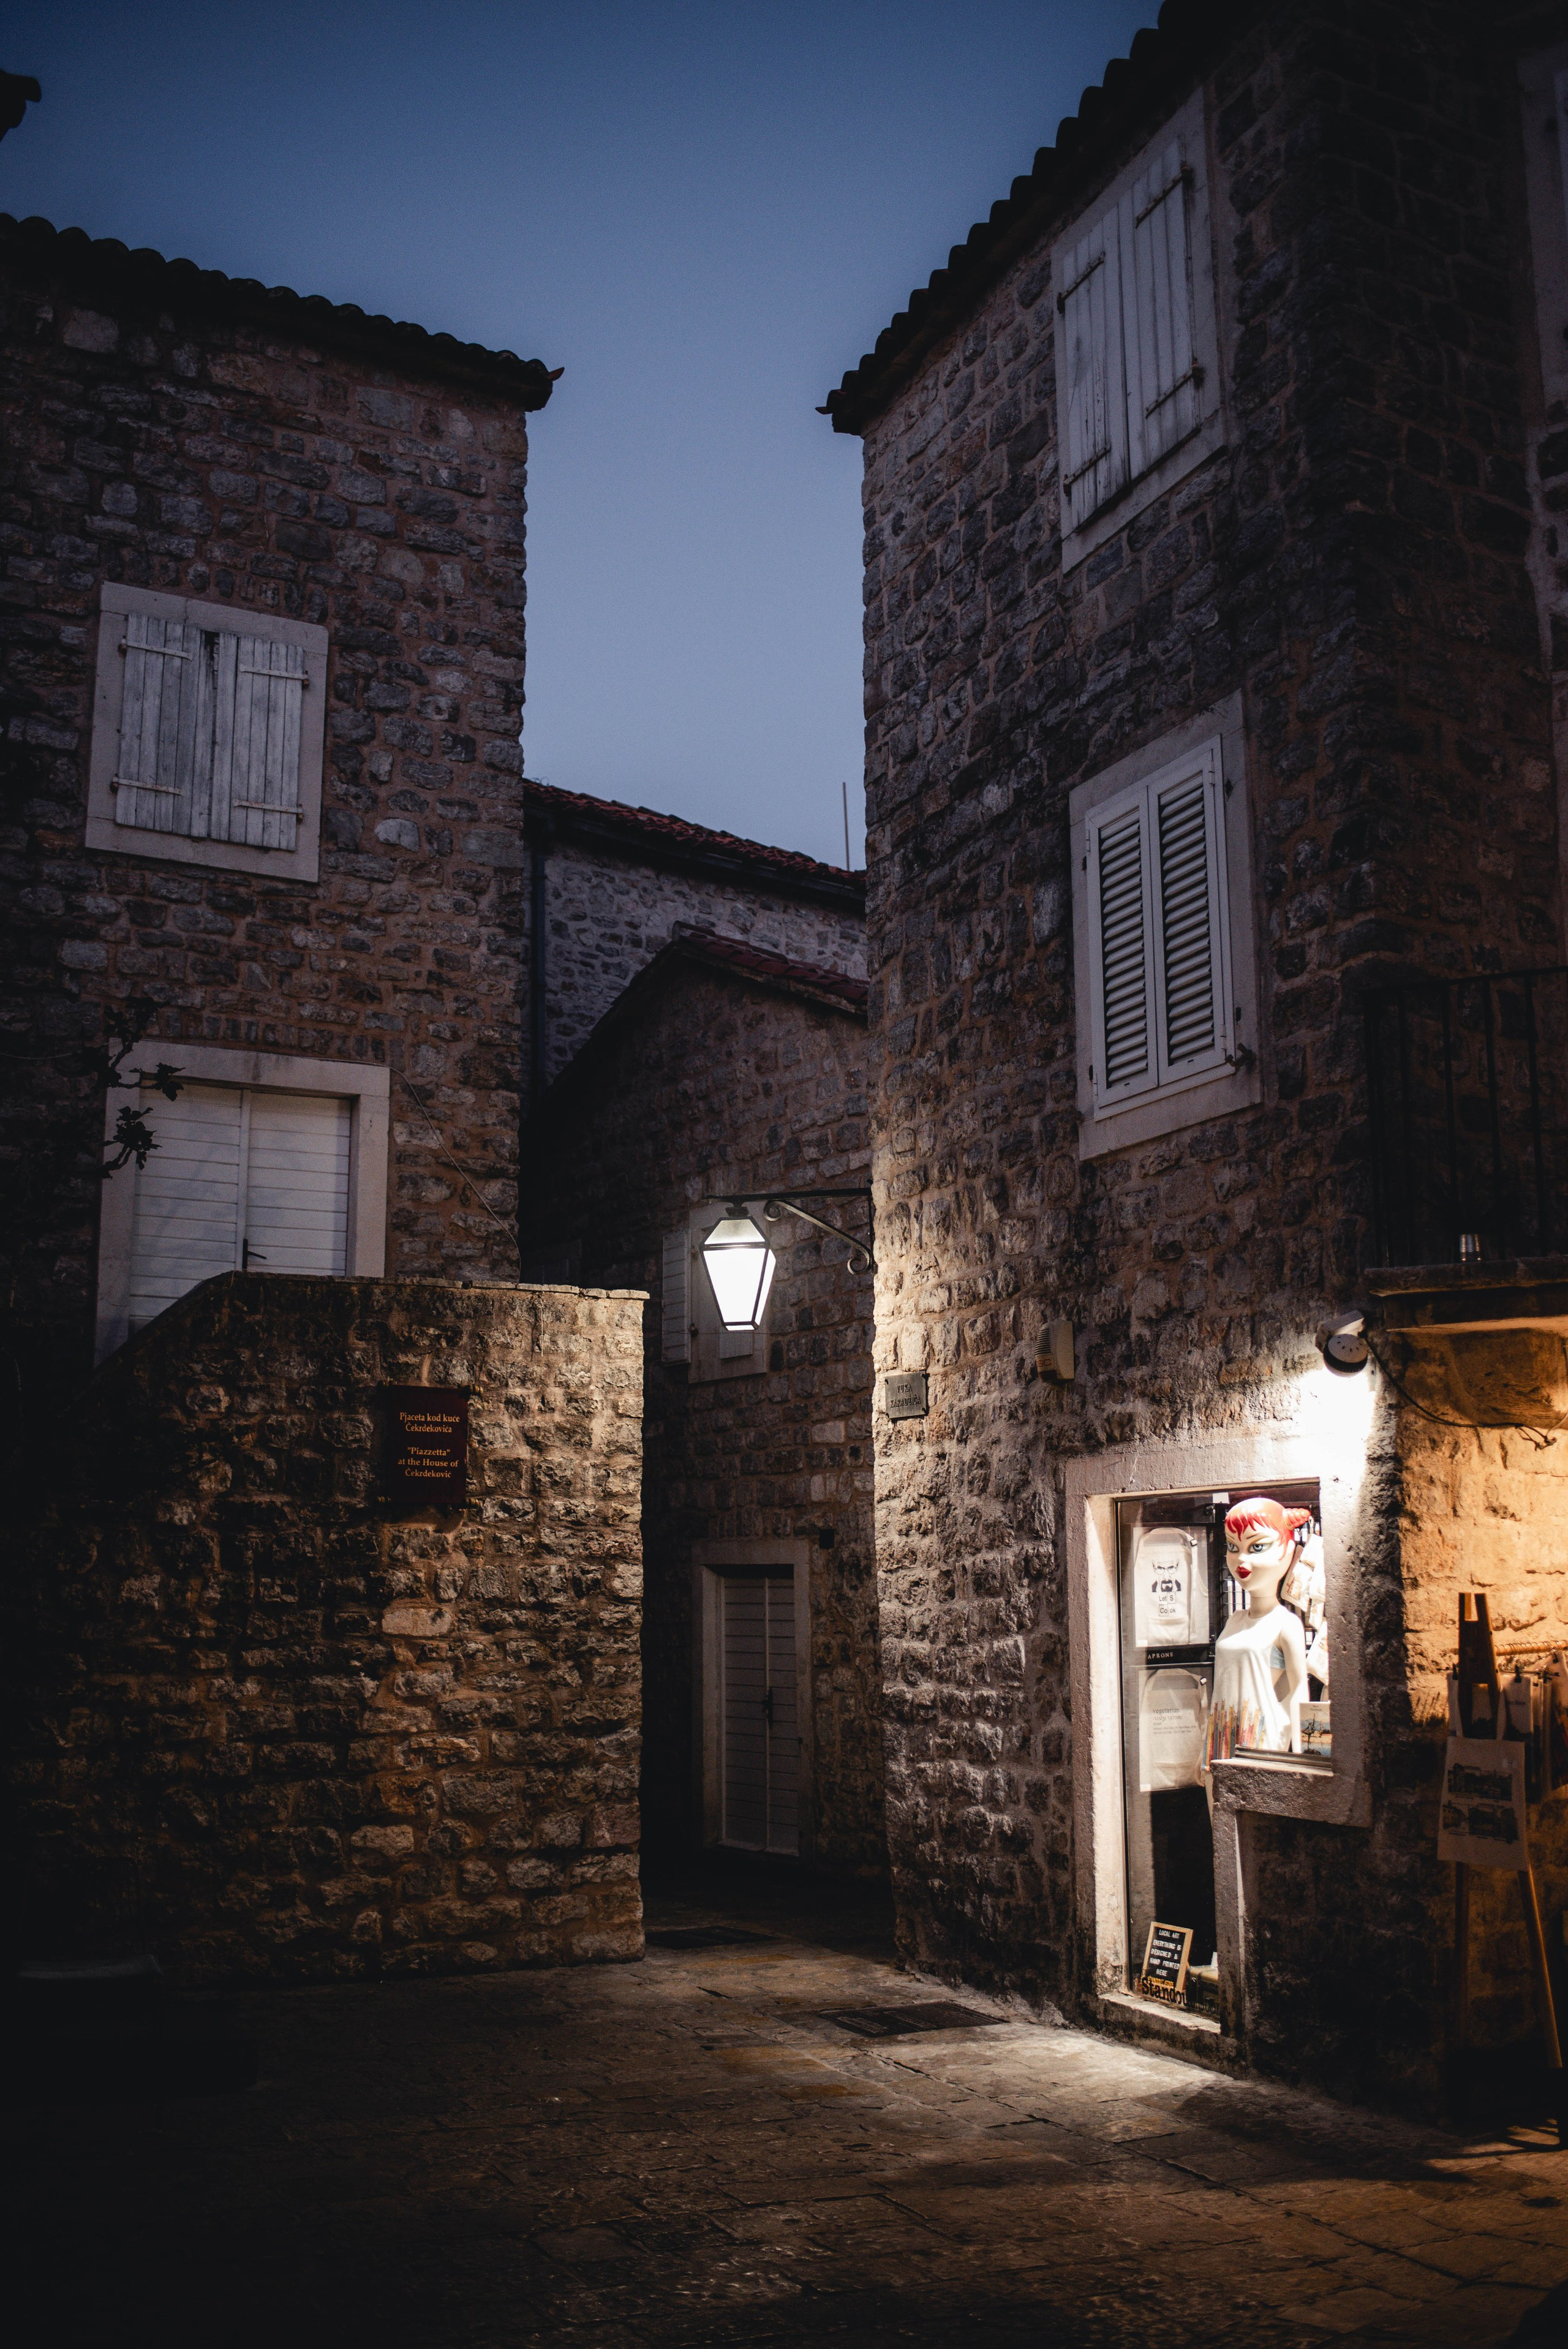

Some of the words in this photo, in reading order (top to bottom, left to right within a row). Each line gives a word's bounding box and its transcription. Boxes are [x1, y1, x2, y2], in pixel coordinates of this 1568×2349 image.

[897, 1383, 912, 1393] VUKA
[399, 1412, 425, 1423] Pjaceta
[427, 1412, 441, 1422] kod
[443, 1414, 461, 1422] kuće
[405, 1422, 453, 1433] Čekrdekovića
[407, 1447, 450, 1456] "Piazzetta"
[1153, 1939, 1176, 1950] EVERYTHING
[1151, 1948, 1171, 1958] DESIGNED
[1162, 1960, 1180, 1970] PRINTED
[1141, 1977, 1192, 2008] Standou
